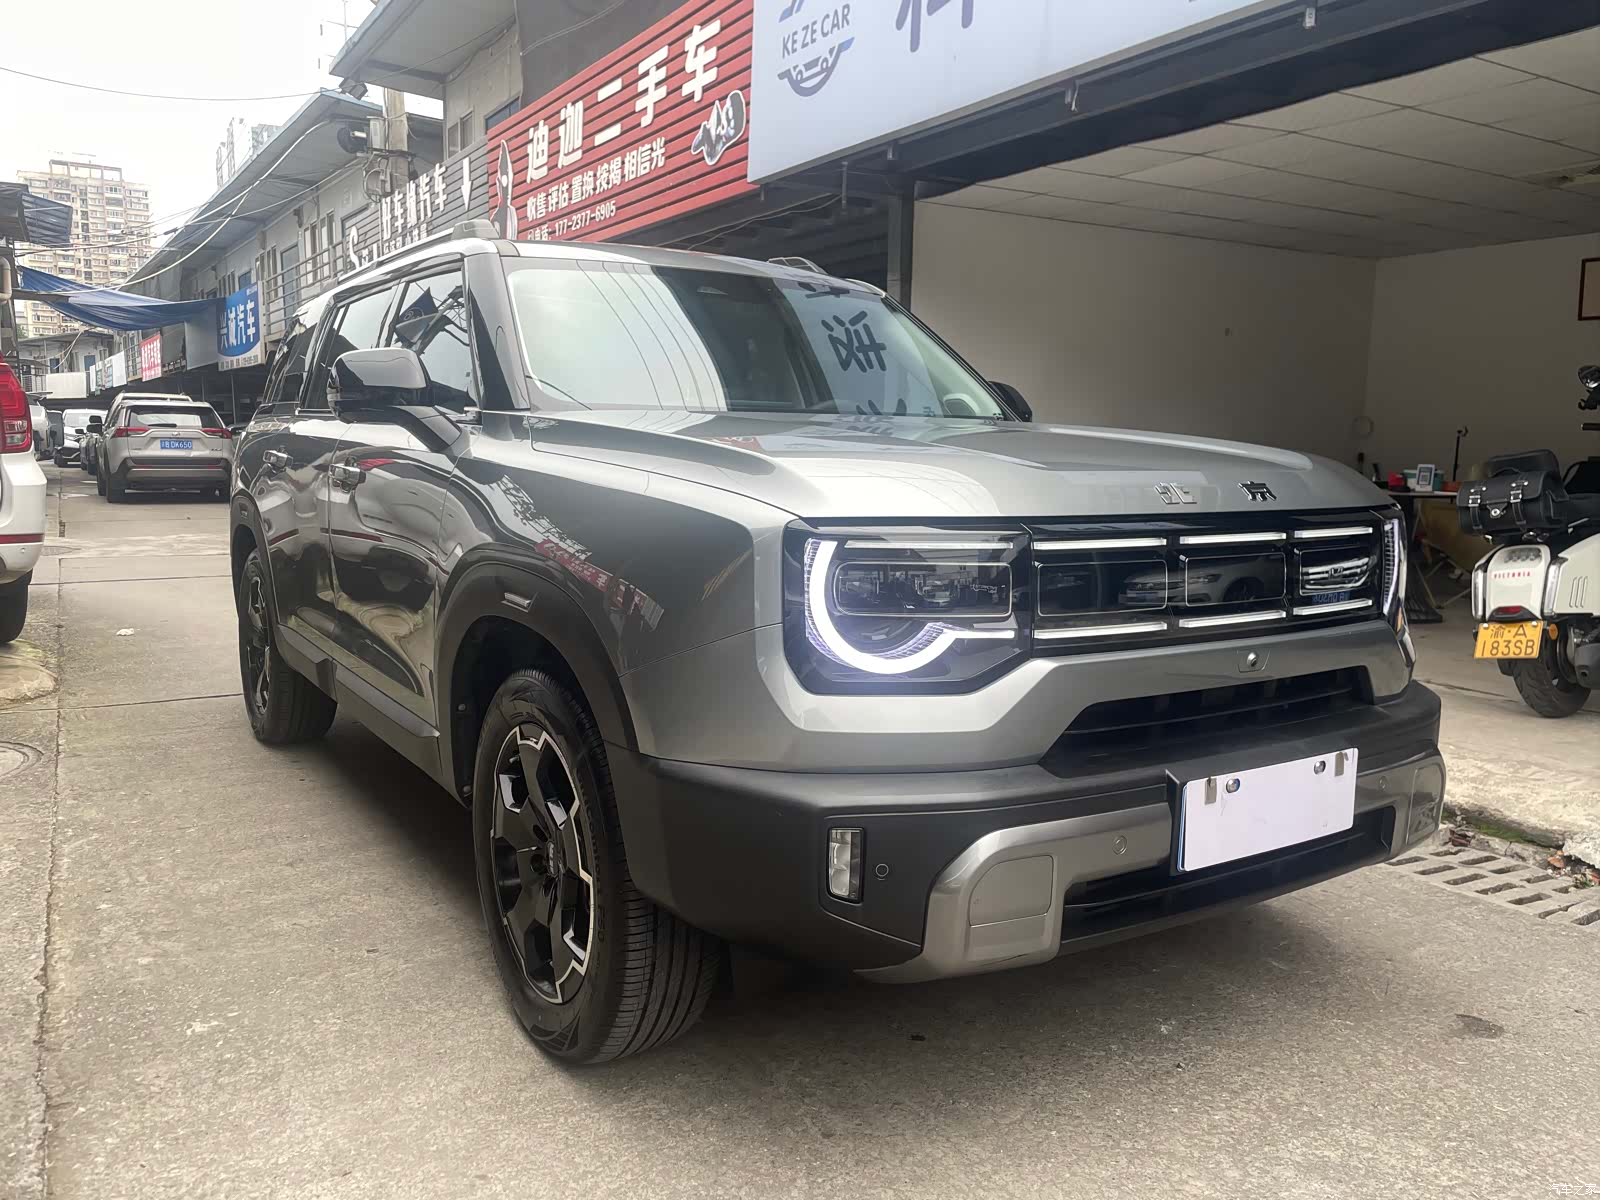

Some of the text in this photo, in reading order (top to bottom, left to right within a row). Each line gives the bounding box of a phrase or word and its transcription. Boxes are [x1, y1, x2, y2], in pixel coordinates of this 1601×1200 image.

[782, 3, 850, 59] KE ZE CAR
[526, 19, 721, 184] 迪迦二手车
[548, 181, 569, 213] 评估
[570, 170, 594, 205] 置换
[624, 136, 666, 182] 相信光
[555, 200, 617, 237] 177-2377-6905
[1481, 639, 1536, 657] 183SB
